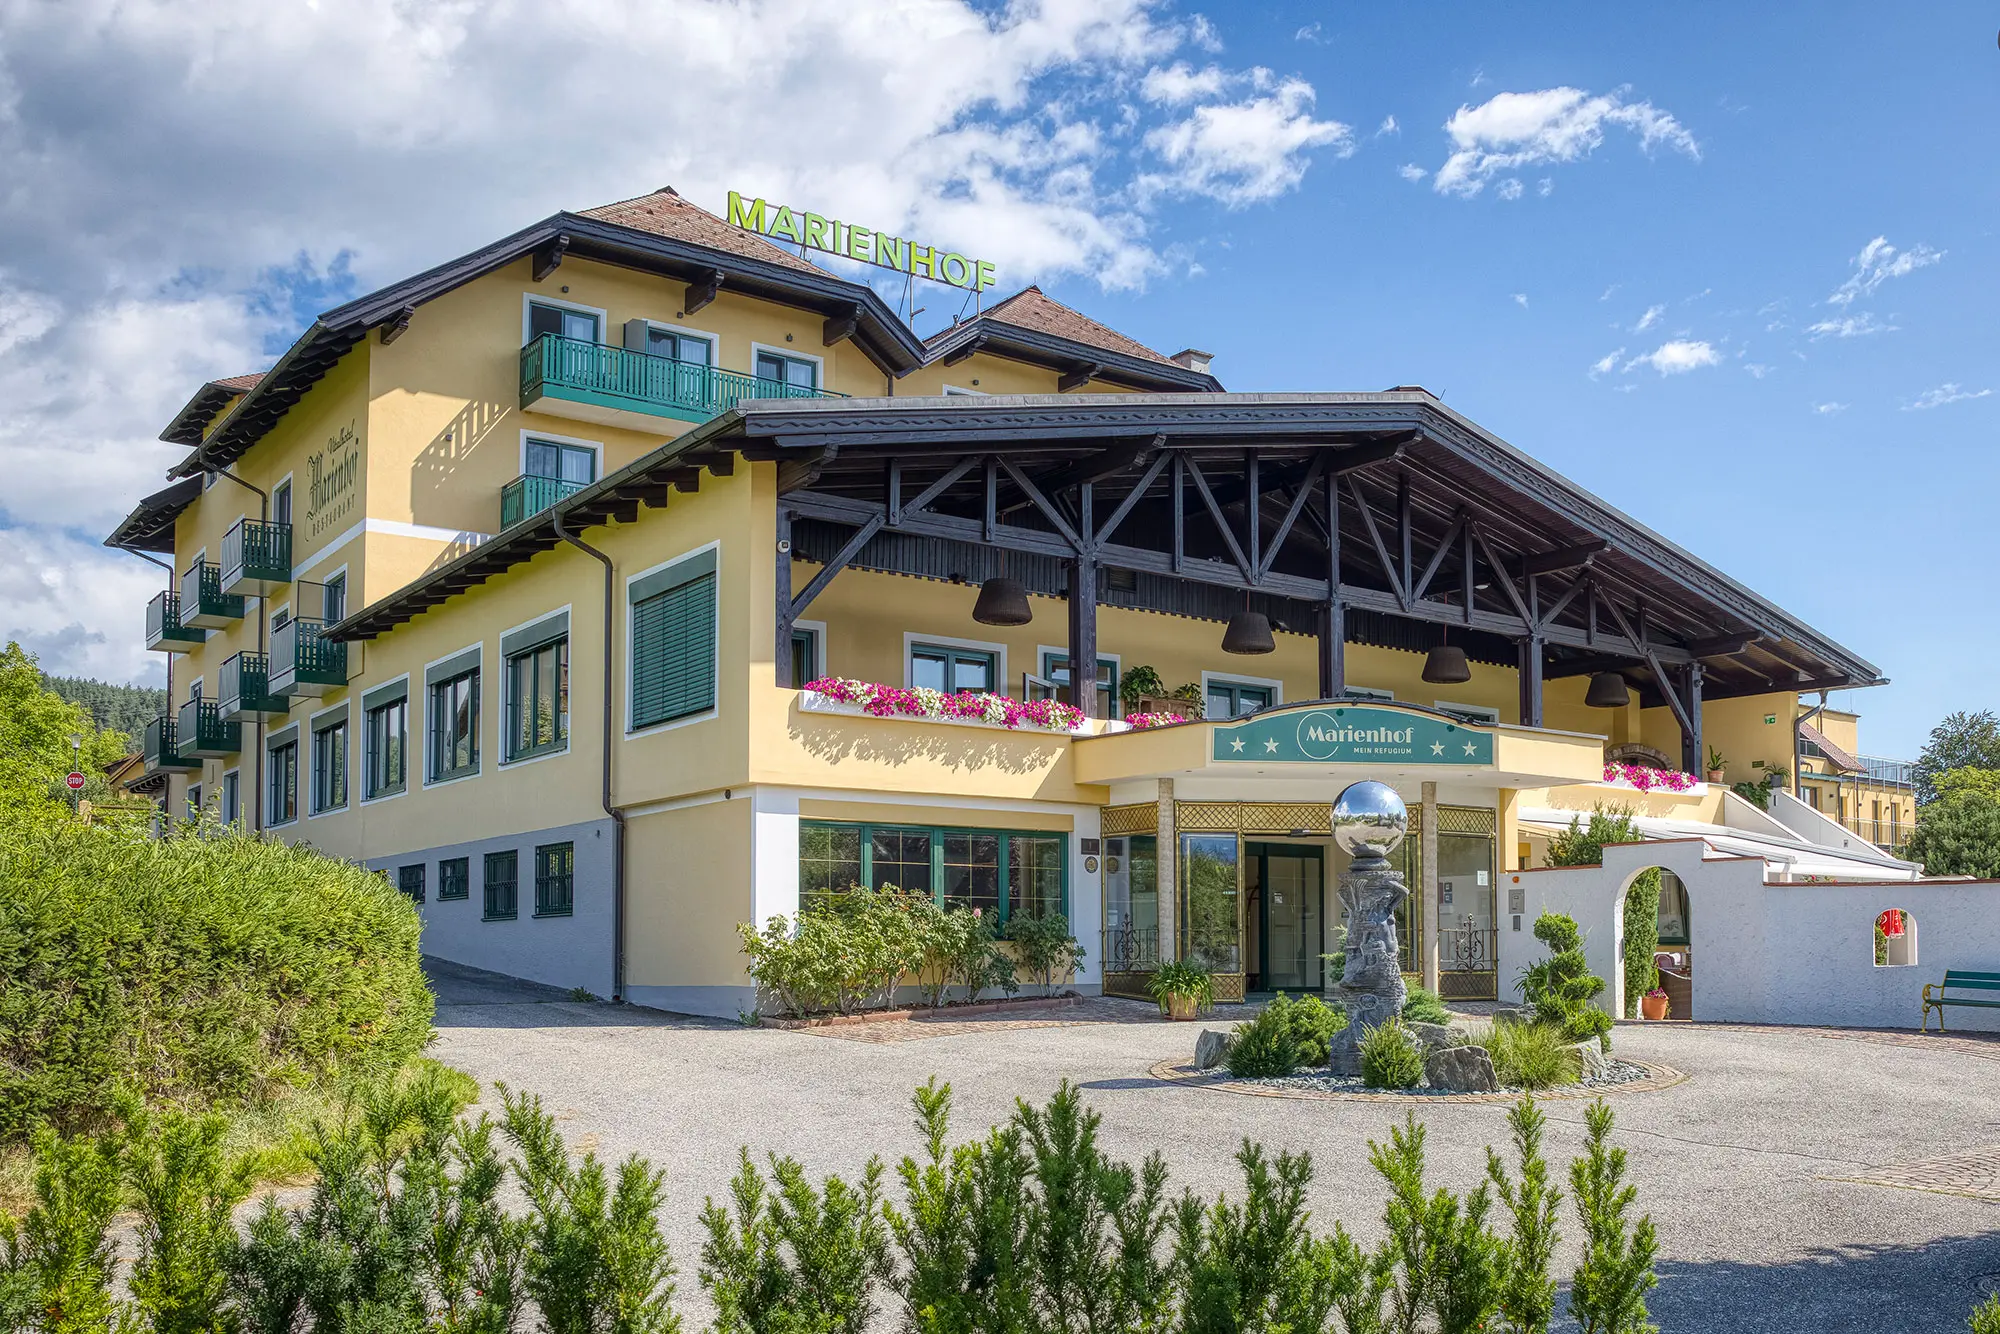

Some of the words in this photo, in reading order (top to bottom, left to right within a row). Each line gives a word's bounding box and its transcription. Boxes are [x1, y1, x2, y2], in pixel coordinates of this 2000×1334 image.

[727, 190, 996, 292] MARIENHOF
[305, 437, 359, 528] Marienhof
[312, 493, 355, 537] RESTAURANT
[1306, 724, 1415, 743] Marienhof
